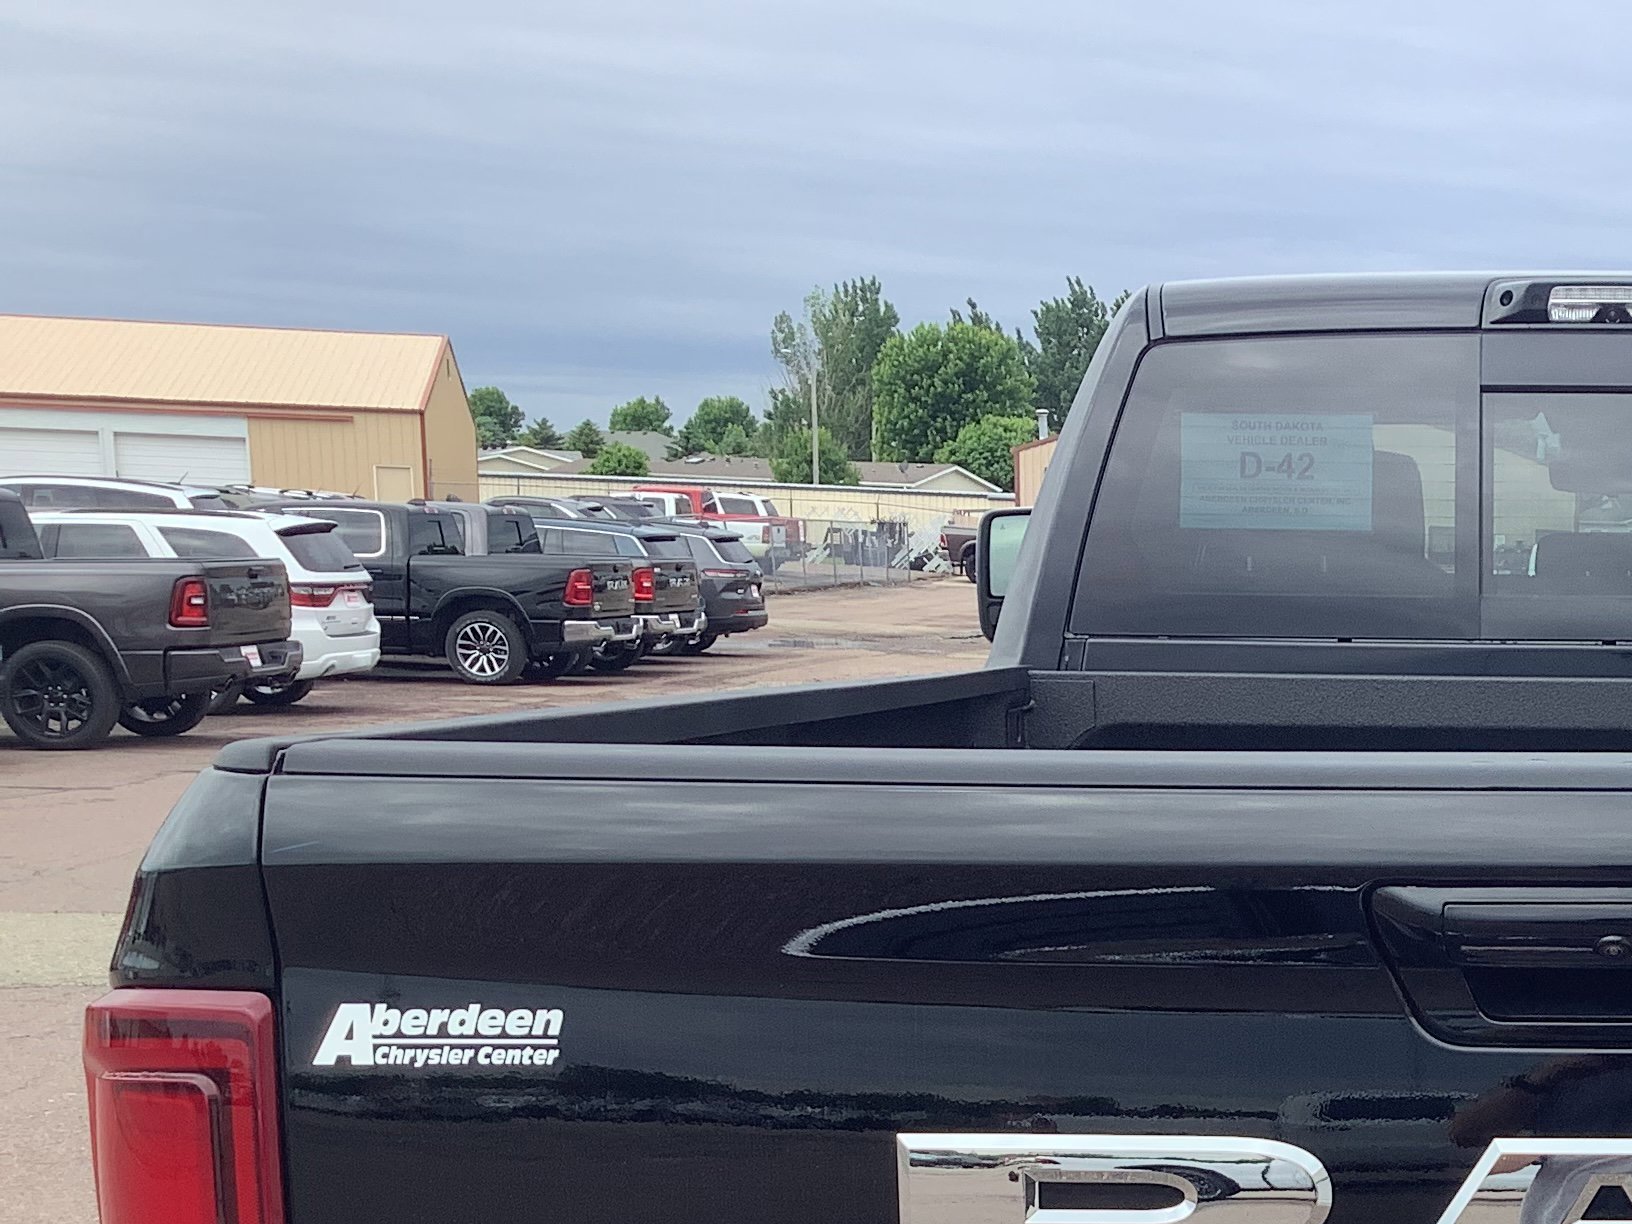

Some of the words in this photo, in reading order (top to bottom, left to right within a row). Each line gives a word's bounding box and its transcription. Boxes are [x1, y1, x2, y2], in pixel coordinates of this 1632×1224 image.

[1231, 420, 1272, 431] SOUTH
[1274, 421, 1325, 432] DAKOTA
[1226, 434, 1277, 446] VEHICLE
[1279, 435, 1328, 447] DEALER
[1239, 450, 1315, 481] D-42
[312, 1003, 564, 1066] Aberdeen
[375, 1045, 475, 1068] Chrysler
[477, 1046, 560, 1066] Center
